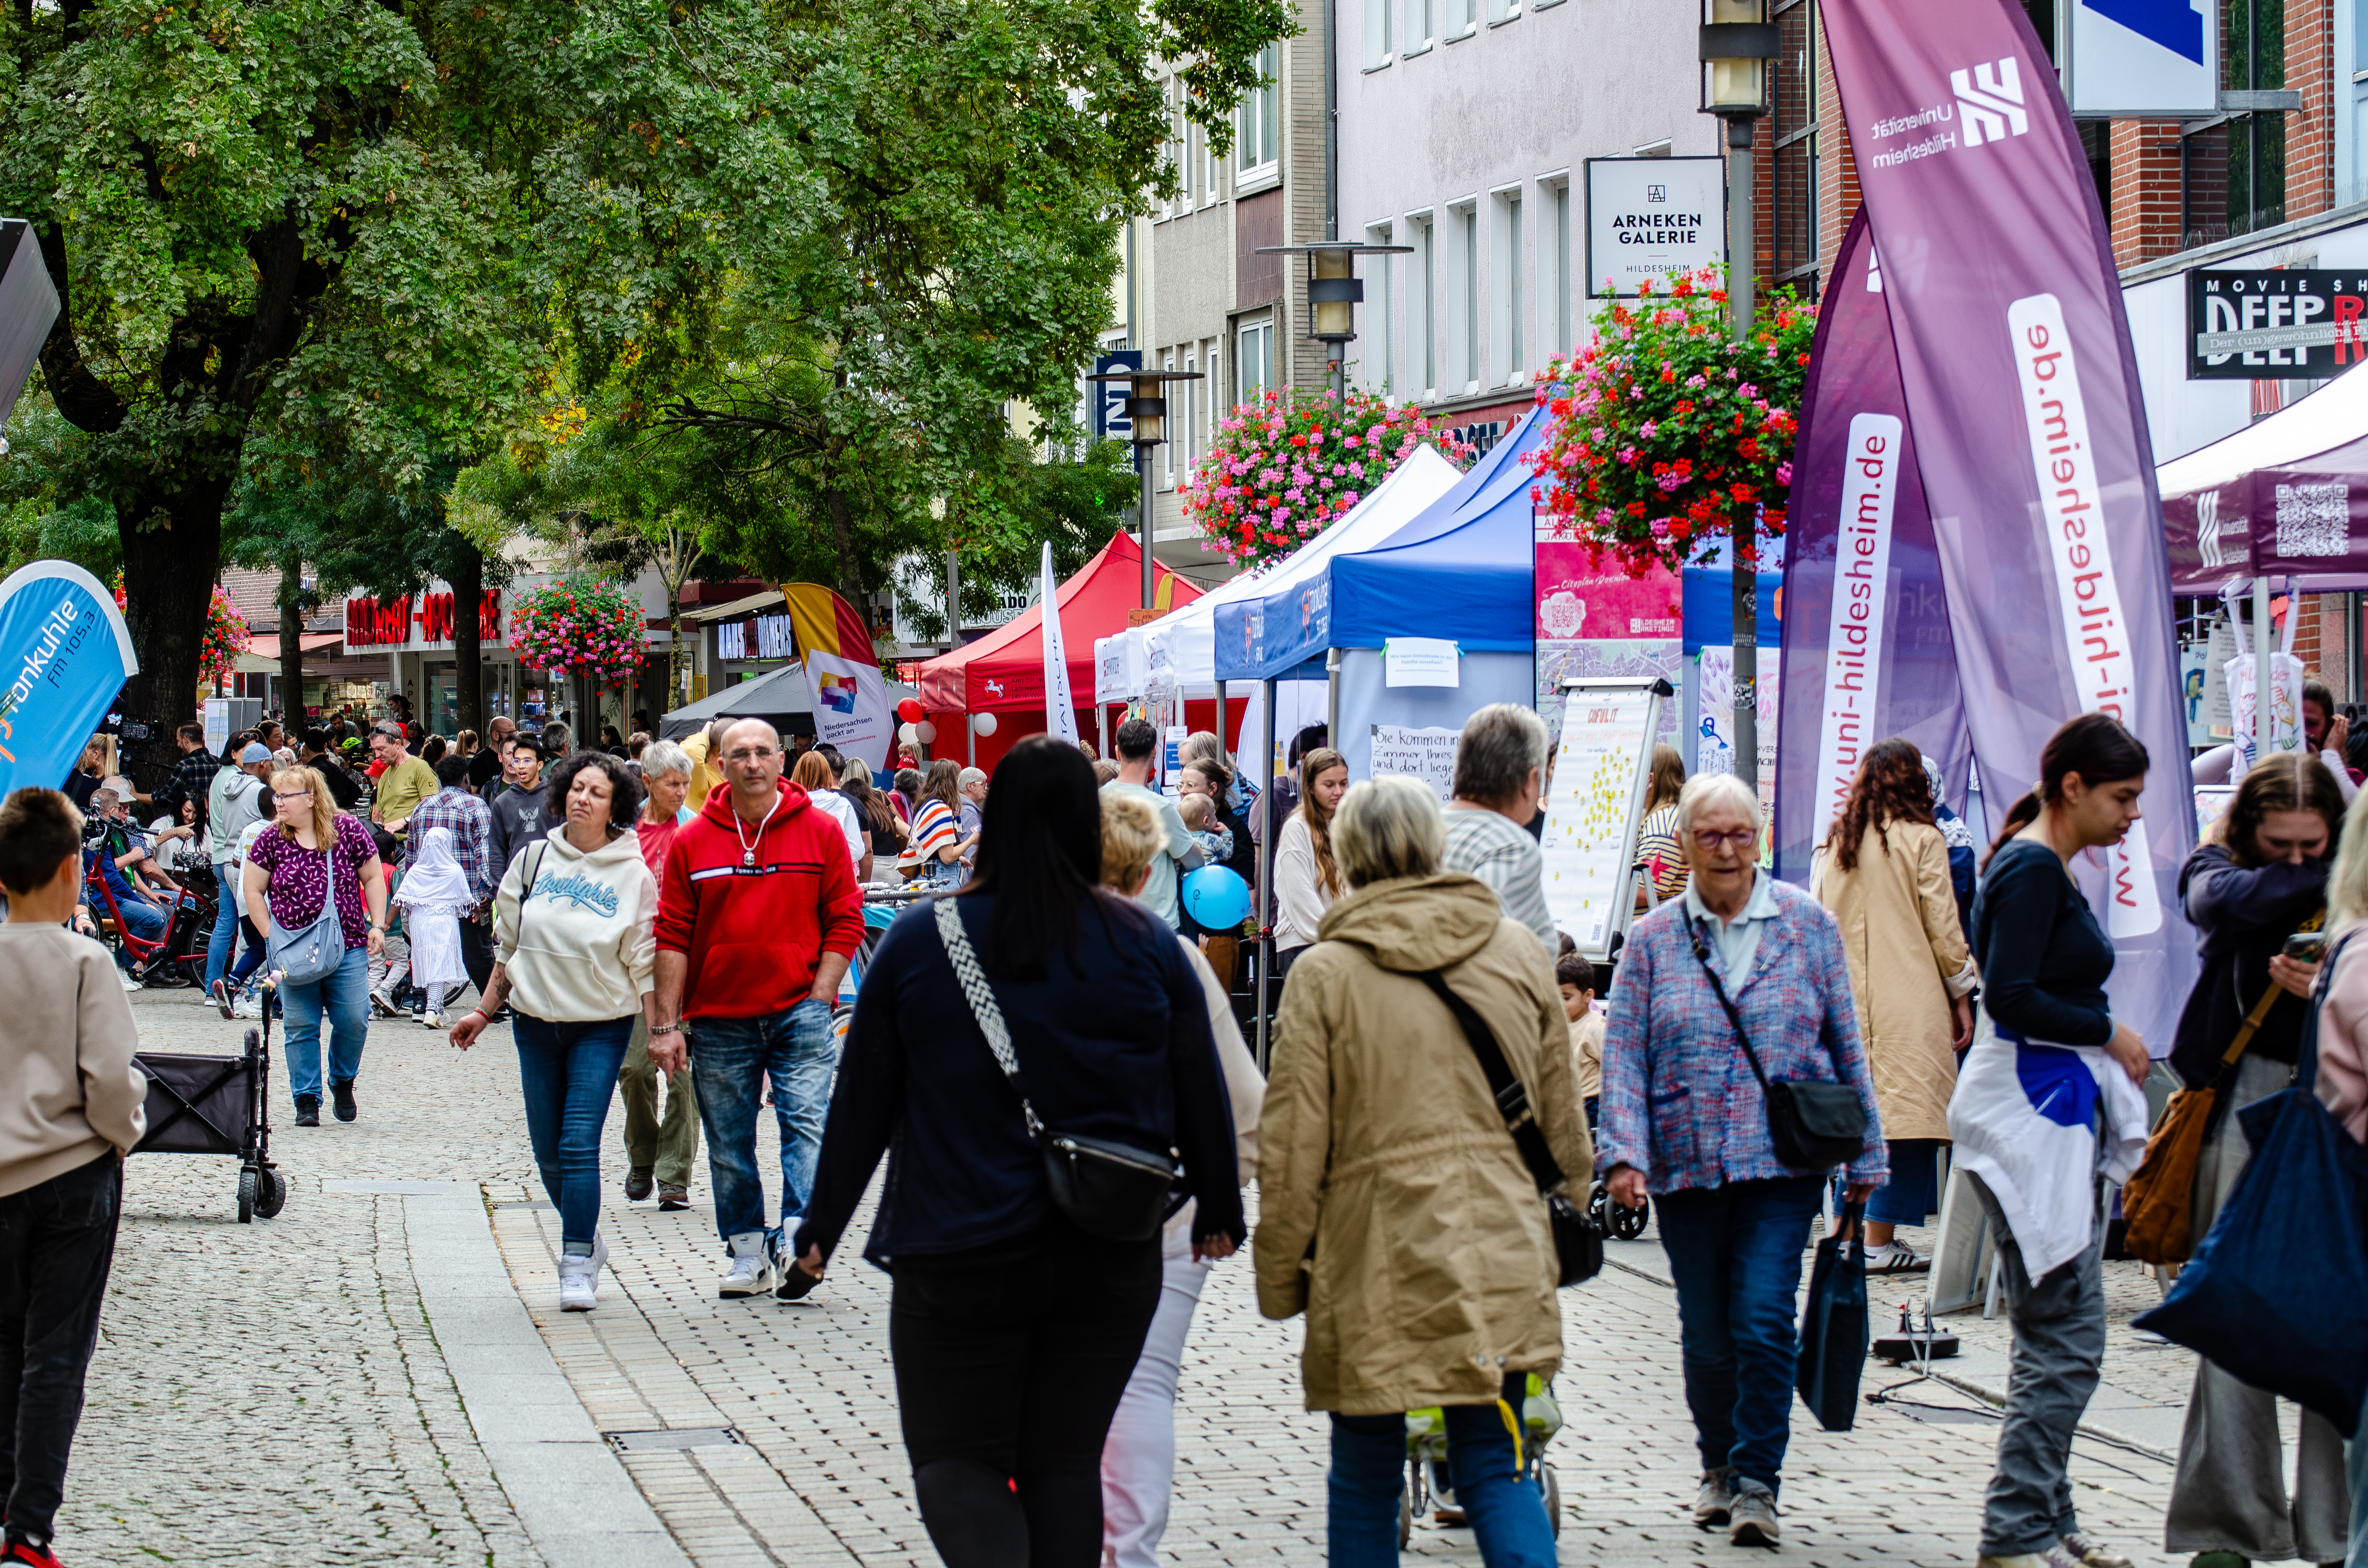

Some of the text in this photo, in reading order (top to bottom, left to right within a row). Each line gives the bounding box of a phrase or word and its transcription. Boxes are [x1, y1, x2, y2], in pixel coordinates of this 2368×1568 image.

[1612, 214, 1701, 228] ARNEKEN
[1619, 231, 1696, 244] GALERIE
[1626, 264, 1690, 273] HILDESHEIM
[2207, 279, 2368, 292] MOVIE SH
[2207, 295, 2368, 365] DEEP R
[2210, 339, 2234, 348] Der
[65, 611, 95, 655] 105,3
[718, 623, 745, 660] HAUS
[824, 717, 873, 732] Niedersachsen
[826, 730, 845, 740] packt
[1376, 727, 1393, 744] Sie
[1399, 730, 1445, 746] kommen
[1373, 745, 1452, 760] Zimmer Ihres
[1373, 759, 1394, 771] und
[1399, 759, 1424, 772] dort
